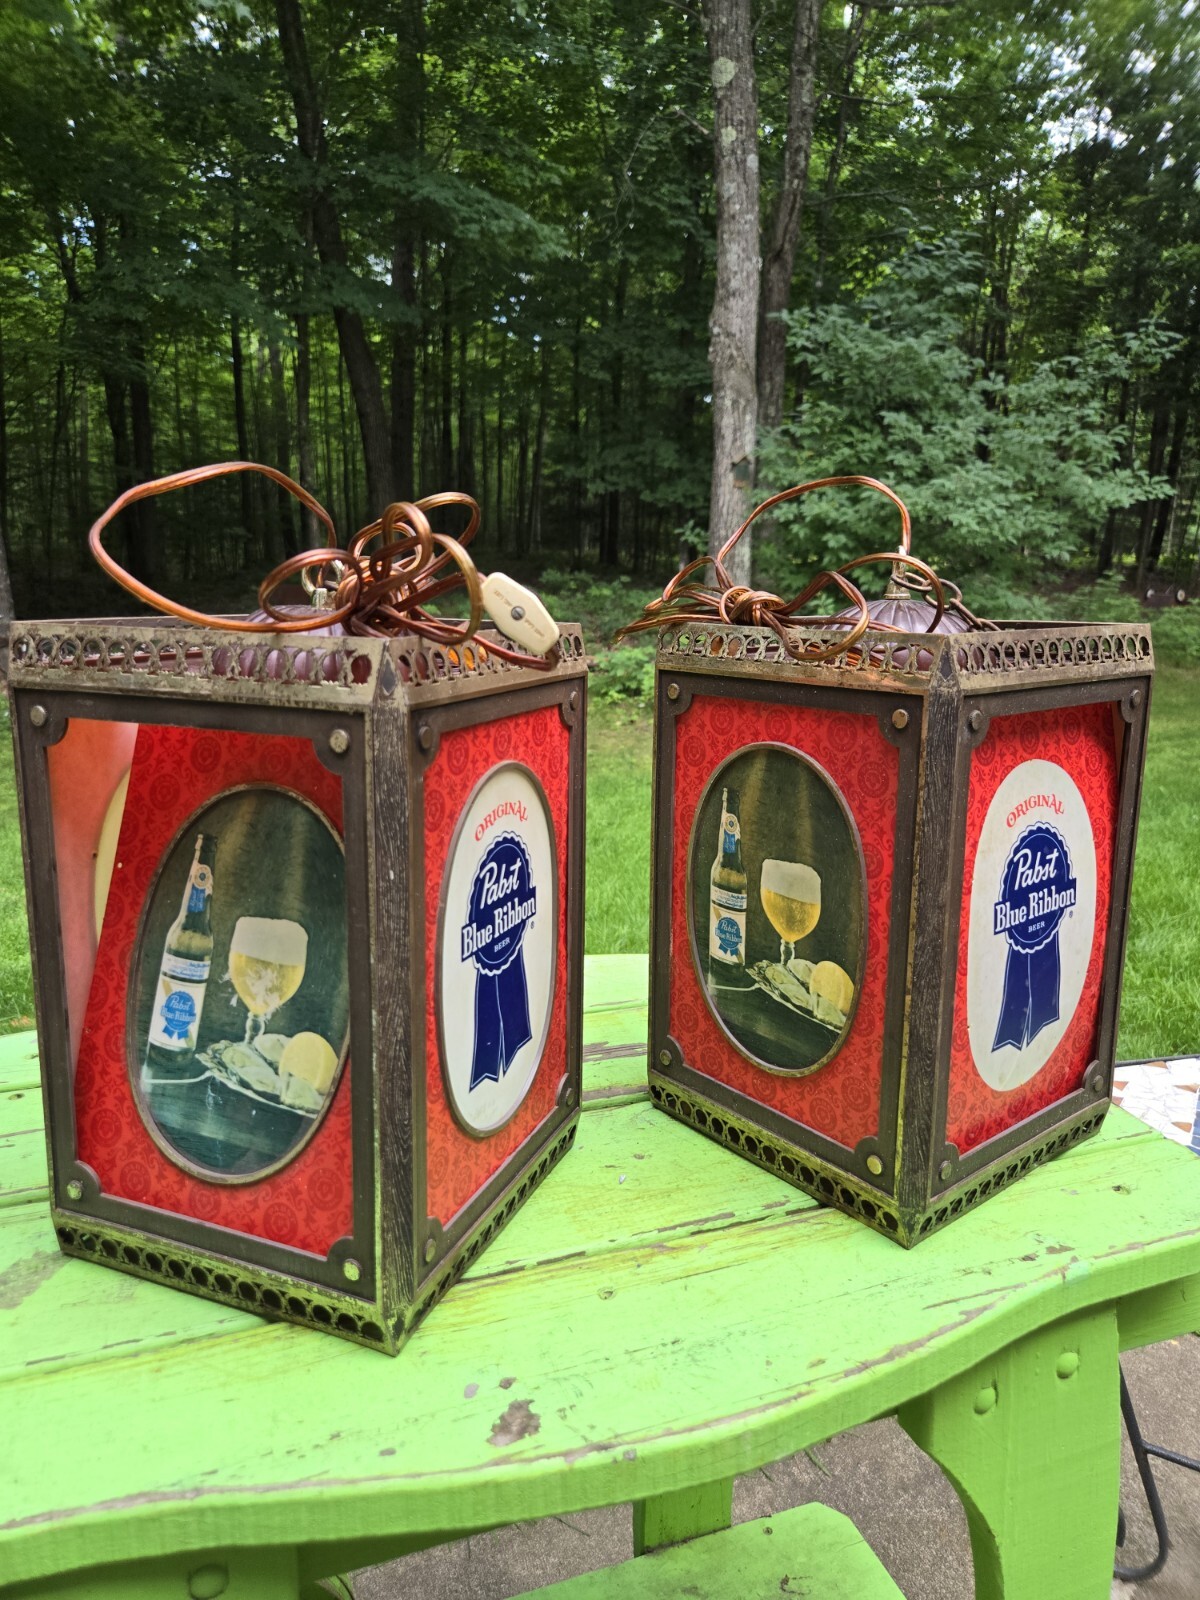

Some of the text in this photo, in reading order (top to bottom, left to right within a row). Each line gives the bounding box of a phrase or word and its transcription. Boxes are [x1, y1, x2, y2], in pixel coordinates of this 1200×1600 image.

[475, 800, 528, 842] ORIGINAL
[1006, 794, 1065, 828] ORIGINAL
[480, 858, 522, 909] Pabst
[1013, 848, 1059, 891] Pabst
[721, 920, 737, 934] Pabst
[995, 885, 1075, 932] Blue Ribbon
[1027, 921, 1045, 933] BEER
[462, 897, 536, 959] Blue Ribbon
[494, 936, 510, 953] BEER
[169, 995, 191, 1011] Pabst
